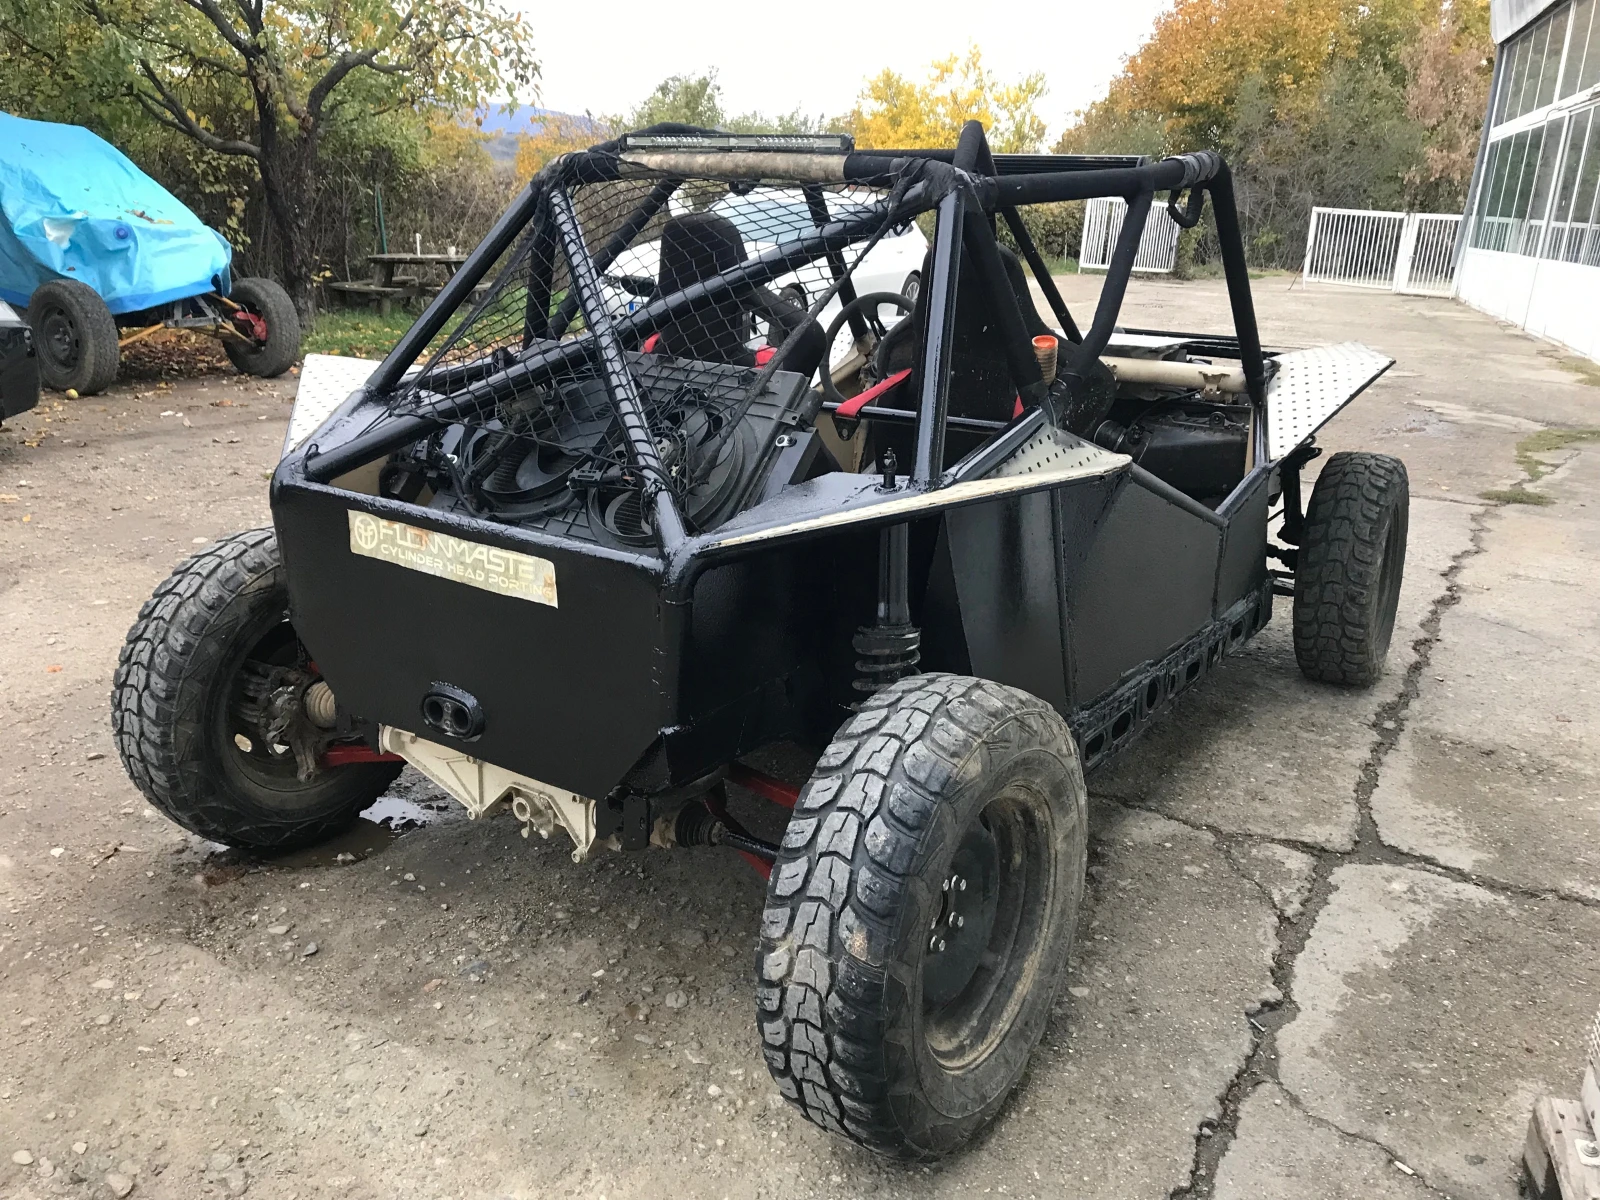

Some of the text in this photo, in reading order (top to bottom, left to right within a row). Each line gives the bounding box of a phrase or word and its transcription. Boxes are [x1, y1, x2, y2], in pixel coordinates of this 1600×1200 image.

[379, 520, 551, 583] FLOWMASTE
[381, 544, 553, 599] CYLINDER HEAD PORTING
